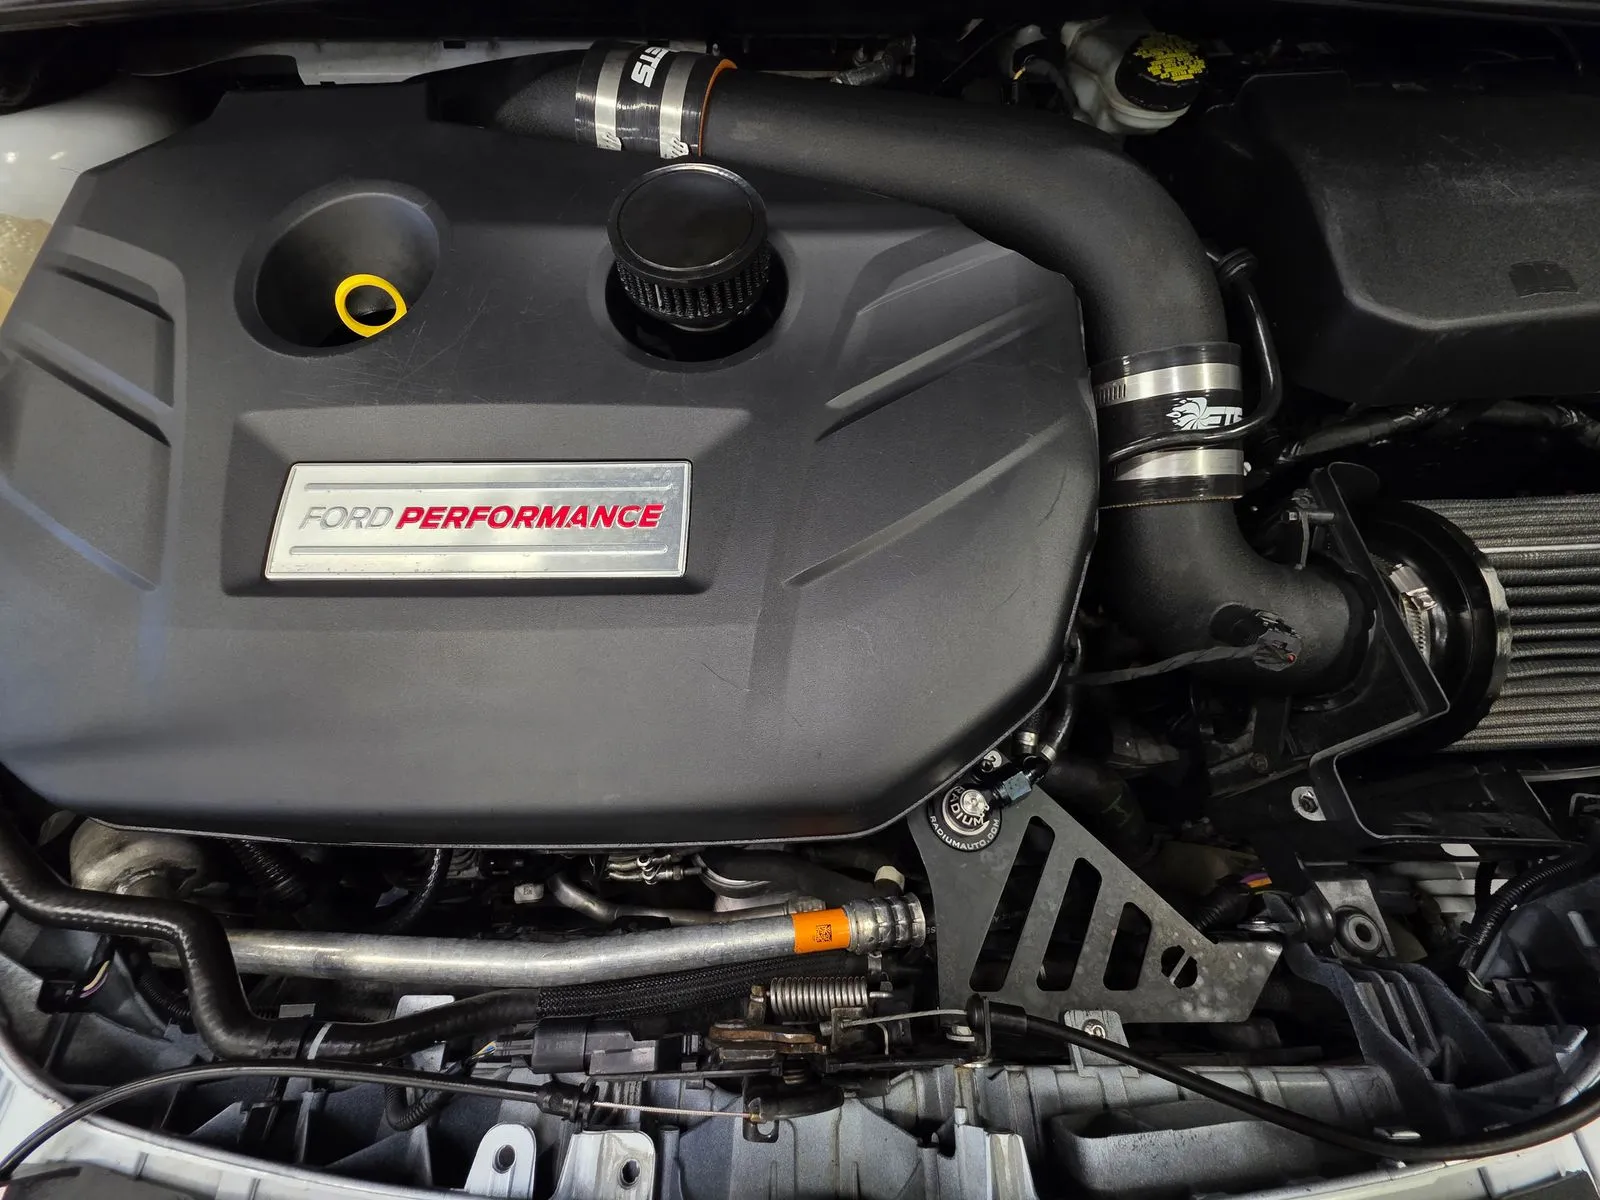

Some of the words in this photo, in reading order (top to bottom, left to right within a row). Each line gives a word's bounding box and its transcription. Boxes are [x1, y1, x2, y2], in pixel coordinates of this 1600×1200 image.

[631, 46, 669, 88] ETS
[299, 506, 394, 530] FORD
[395, 503, 664, 529] PERFORMANCE
[949, 786, 984, 826] RADIUM
[929, 815, 1000, 850] RADIUMAUTO.COM
